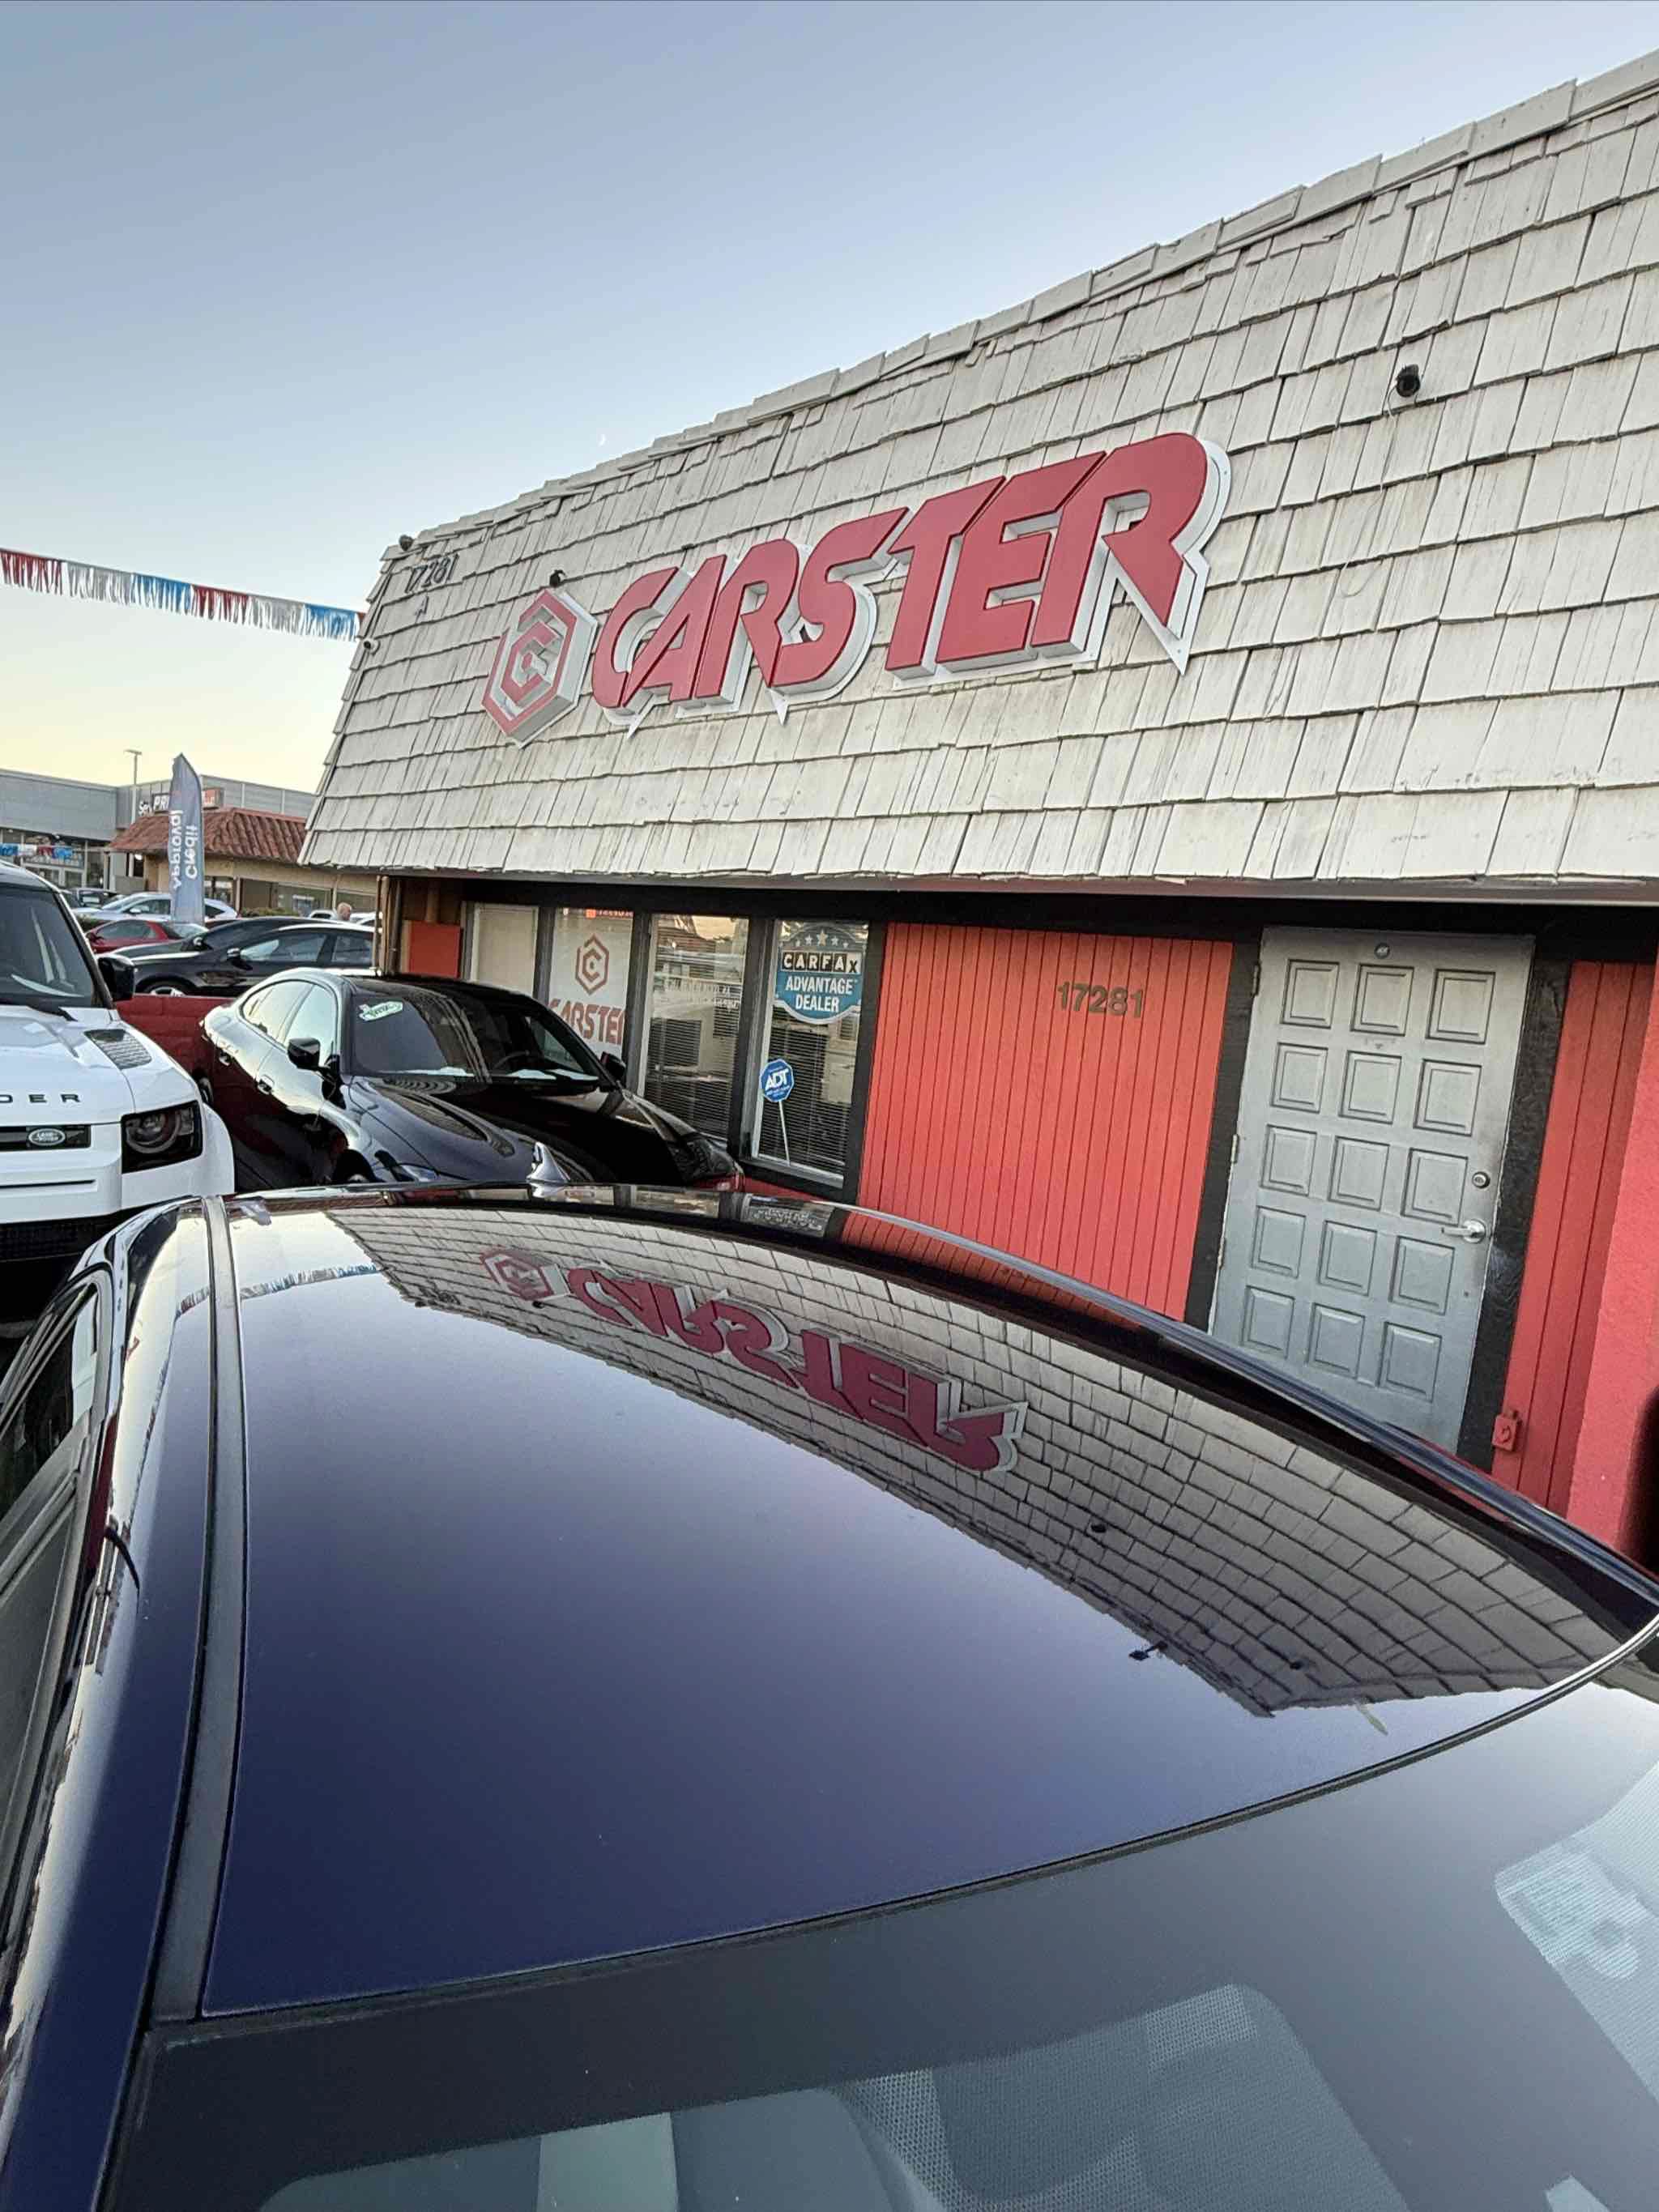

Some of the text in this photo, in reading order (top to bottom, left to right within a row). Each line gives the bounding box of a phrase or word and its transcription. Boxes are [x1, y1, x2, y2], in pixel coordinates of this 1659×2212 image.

[405, 554, 459, 594] 17281
[591, 433, 1226, 731] CARSTER
[783, 953, 858, 974] CARFAX
[785, 976, 853, 995] ADVANTAGE
[795, 994, 840, 1012] DEALER
[1057, 981, 1144, 1018] 17281
[766, 1068, 789, 1090] ADT
